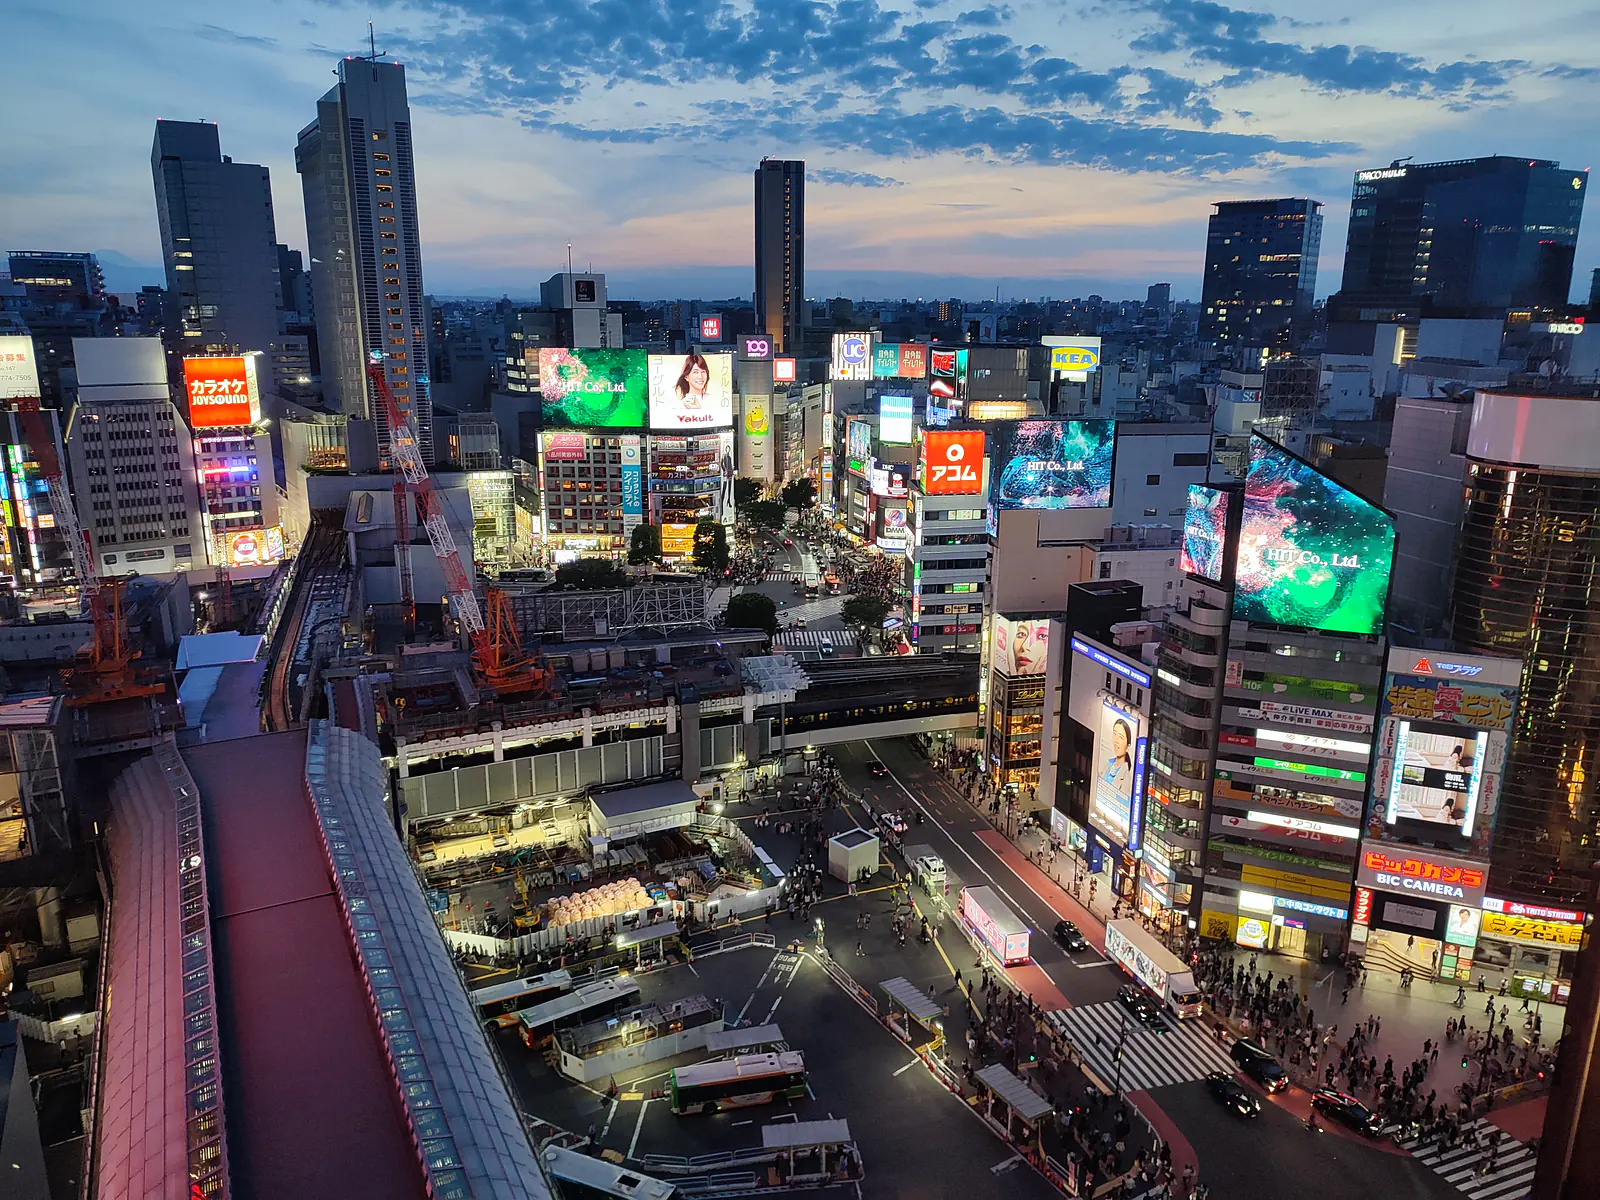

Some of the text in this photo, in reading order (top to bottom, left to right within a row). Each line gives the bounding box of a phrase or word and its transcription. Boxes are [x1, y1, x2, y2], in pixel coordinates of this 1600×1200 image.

[1359, 171, 1381, 180] PARCO
[704, 320, 717, 328] UNI
[704, 328, 718, 336] QLO
[746, 340, 768, 357] 109
[1055, 353, 1093, 364] KEA
[190, 378, 245, 394] カラオケ
[561, 382, 581, 393] HIT
[607, 382, 627, 393] Ltd.
[720, 355, 730, 408] ヤクルトの
[192, 394, 248, 405] JOYSOUND
[676, 414, 714, 424] Yakult
[1027, 460, 1085, 472] HIT Co., Ltd.
[931, 465, 977, 482] アコム
[624, 470, 633, 507] アイシティ
[1267, 548, 1361, 568] HIT Co., Ltd.
[1312, 709, 1333, 718] MAX
[1466, 716, 1505, 728] VISION
[1295, 820, 1322, 831] アコム
[1285, 827, 1322, 841] アコム
[1365, 851, 1483, 888] ビックカメラ
[1377, 873, 1464, 898] BIC CAMERA
[1287, 899, 1336, 916] 中央コンタクト
[1356, 890, 1370, 920] カラオケ
